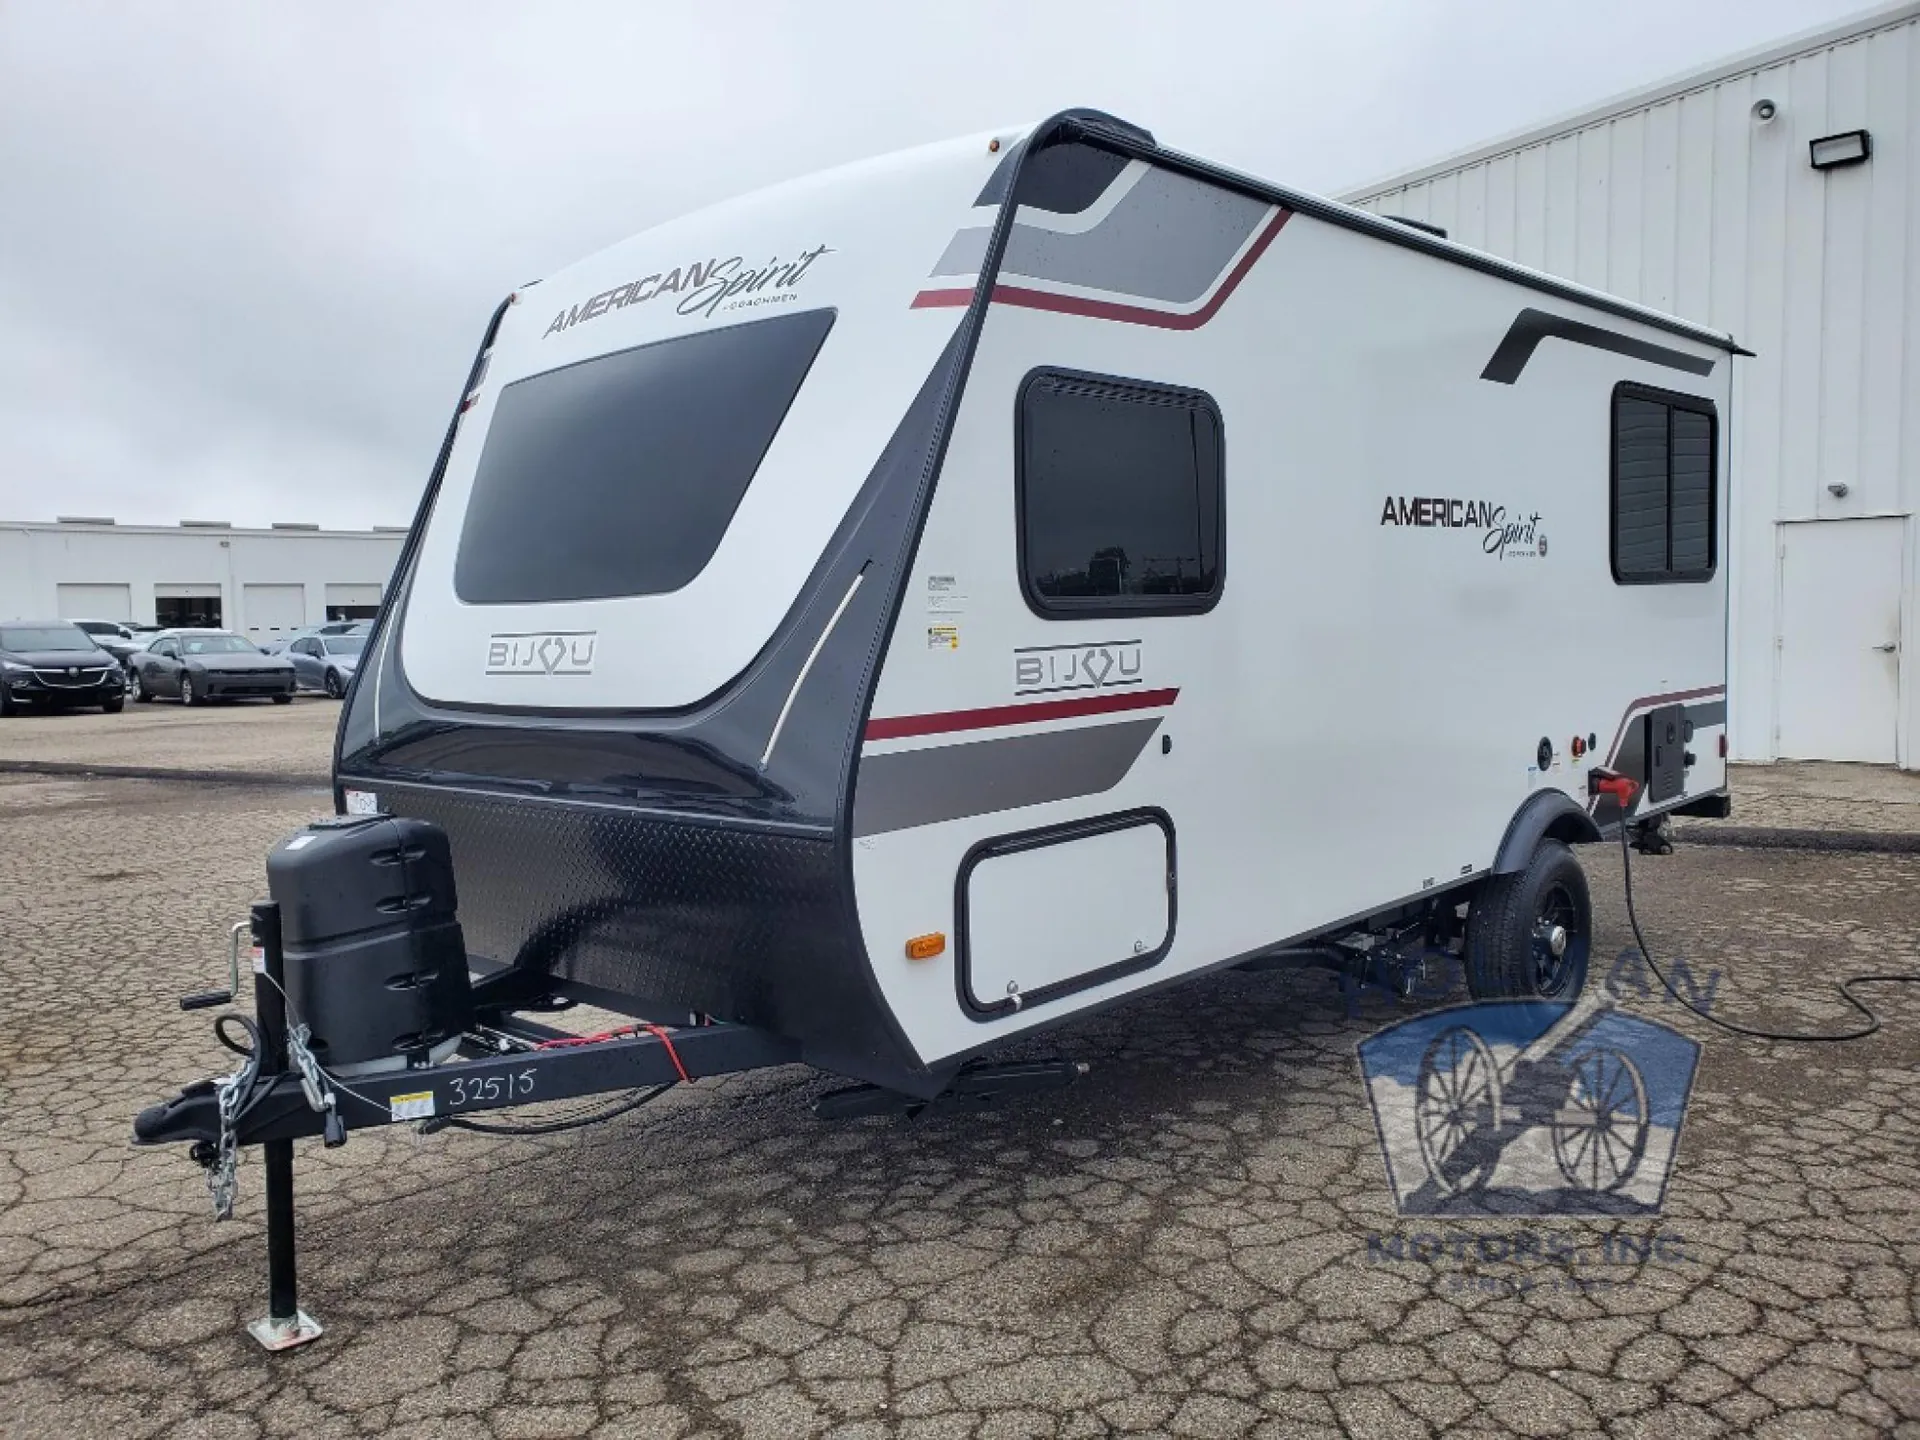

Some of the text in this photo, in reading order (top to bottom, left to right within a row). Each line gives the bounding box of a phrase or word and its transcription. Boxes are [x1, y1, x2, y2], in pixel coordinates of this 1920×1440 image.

[541, 244, 838, 340] AMERICAN Spirit
[1380, 496, 1543, 561] AMERICAN Spirit
[487, 636, 595, 676] BIJOU
[1015, 648, 1141, 689] BIJOU
[449, 1068, 538, 1106] 32515
